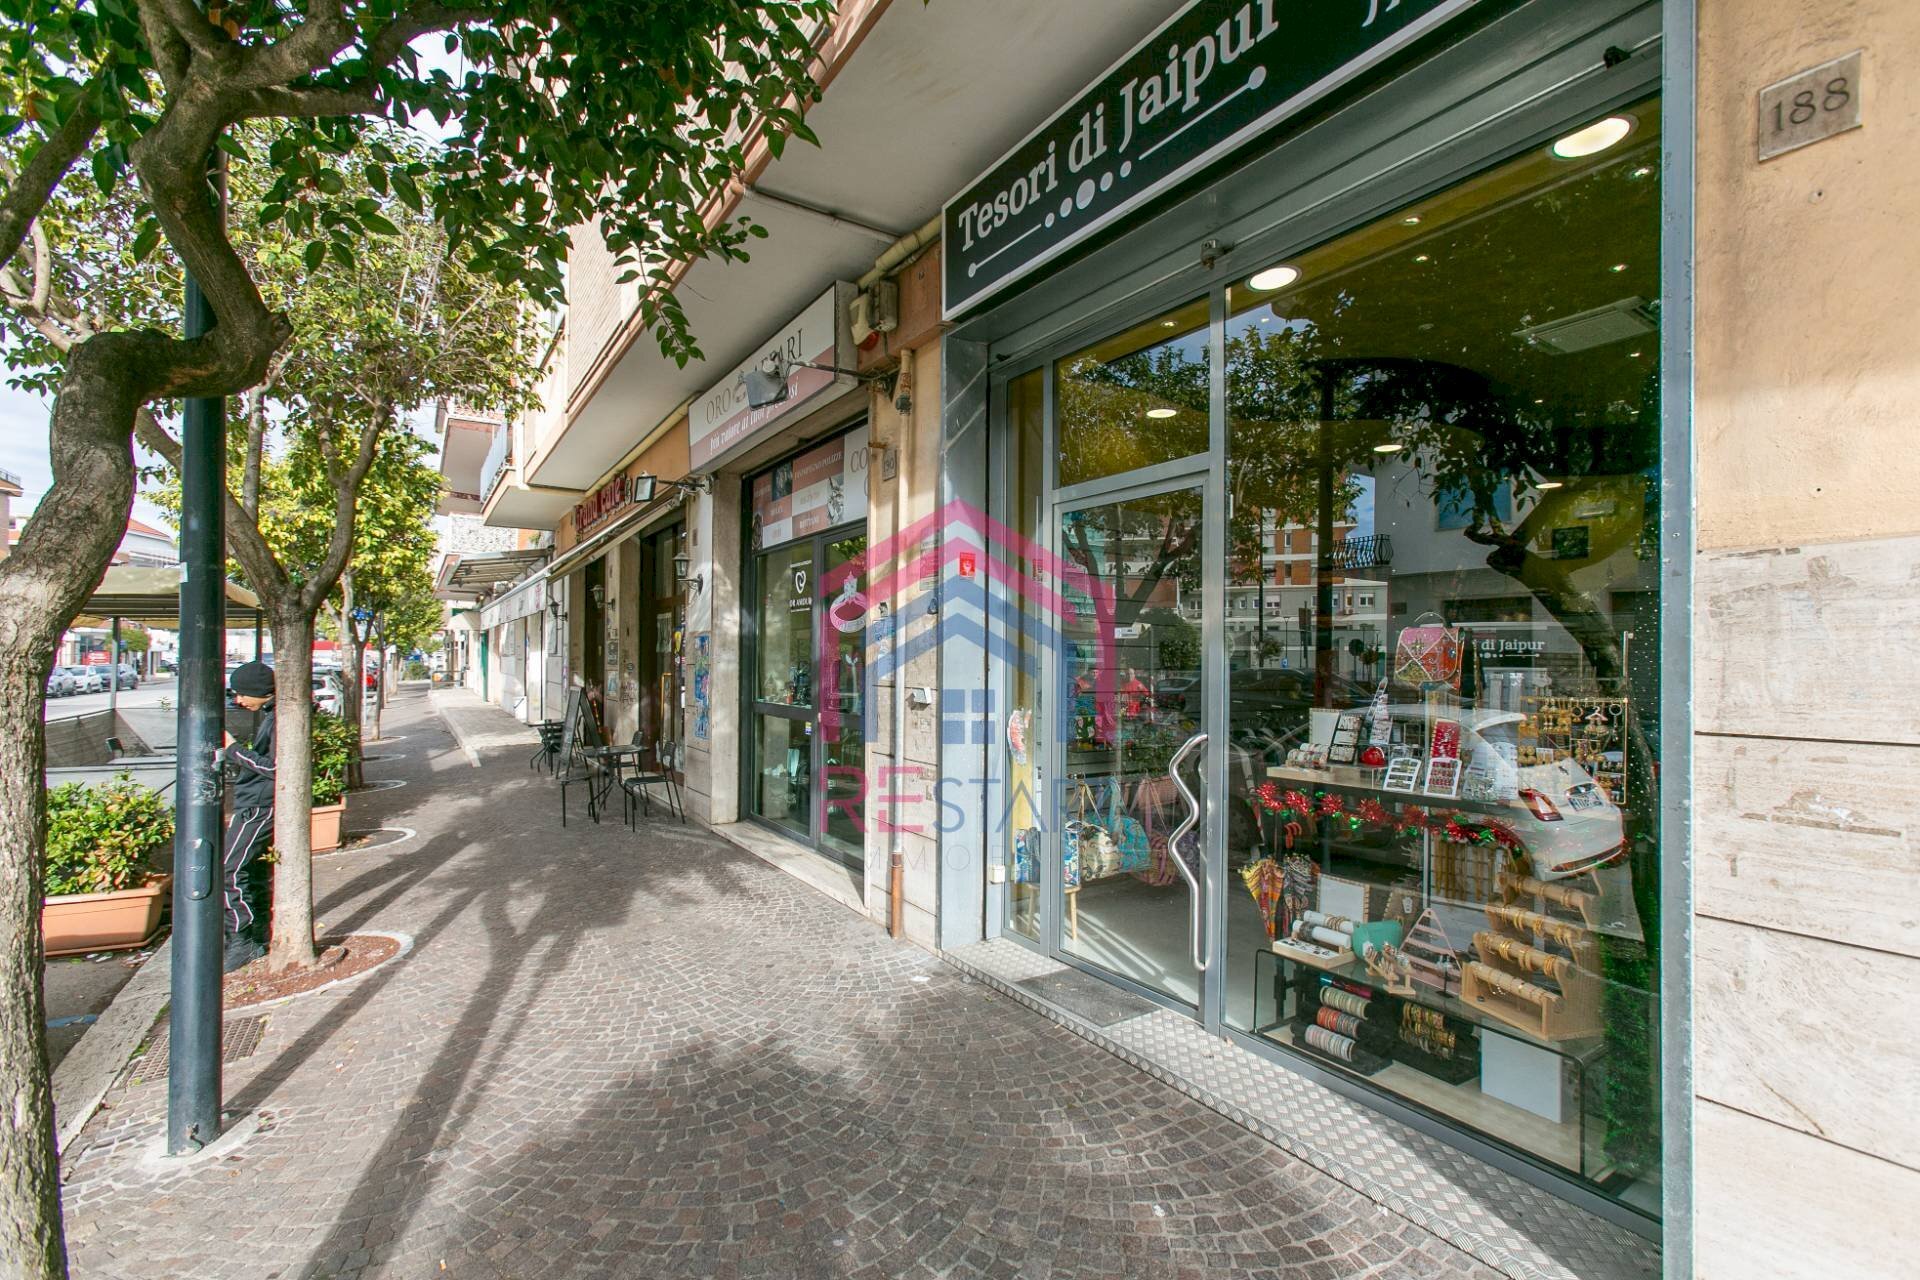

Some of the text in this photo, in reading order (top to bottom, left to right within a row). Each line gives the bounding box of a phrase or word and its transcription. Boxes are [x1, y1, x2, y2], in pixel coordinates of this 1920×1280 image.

[1773, 77, 1851, 132] 188
[958, 140, 1057, 251] Tesori
[1067, 102, 1108, 174] di
[705, 387, 731, 424] ORO
[1481, 638, 1495, 651] di
[1498, 638, 1545, 653] Jaipur
